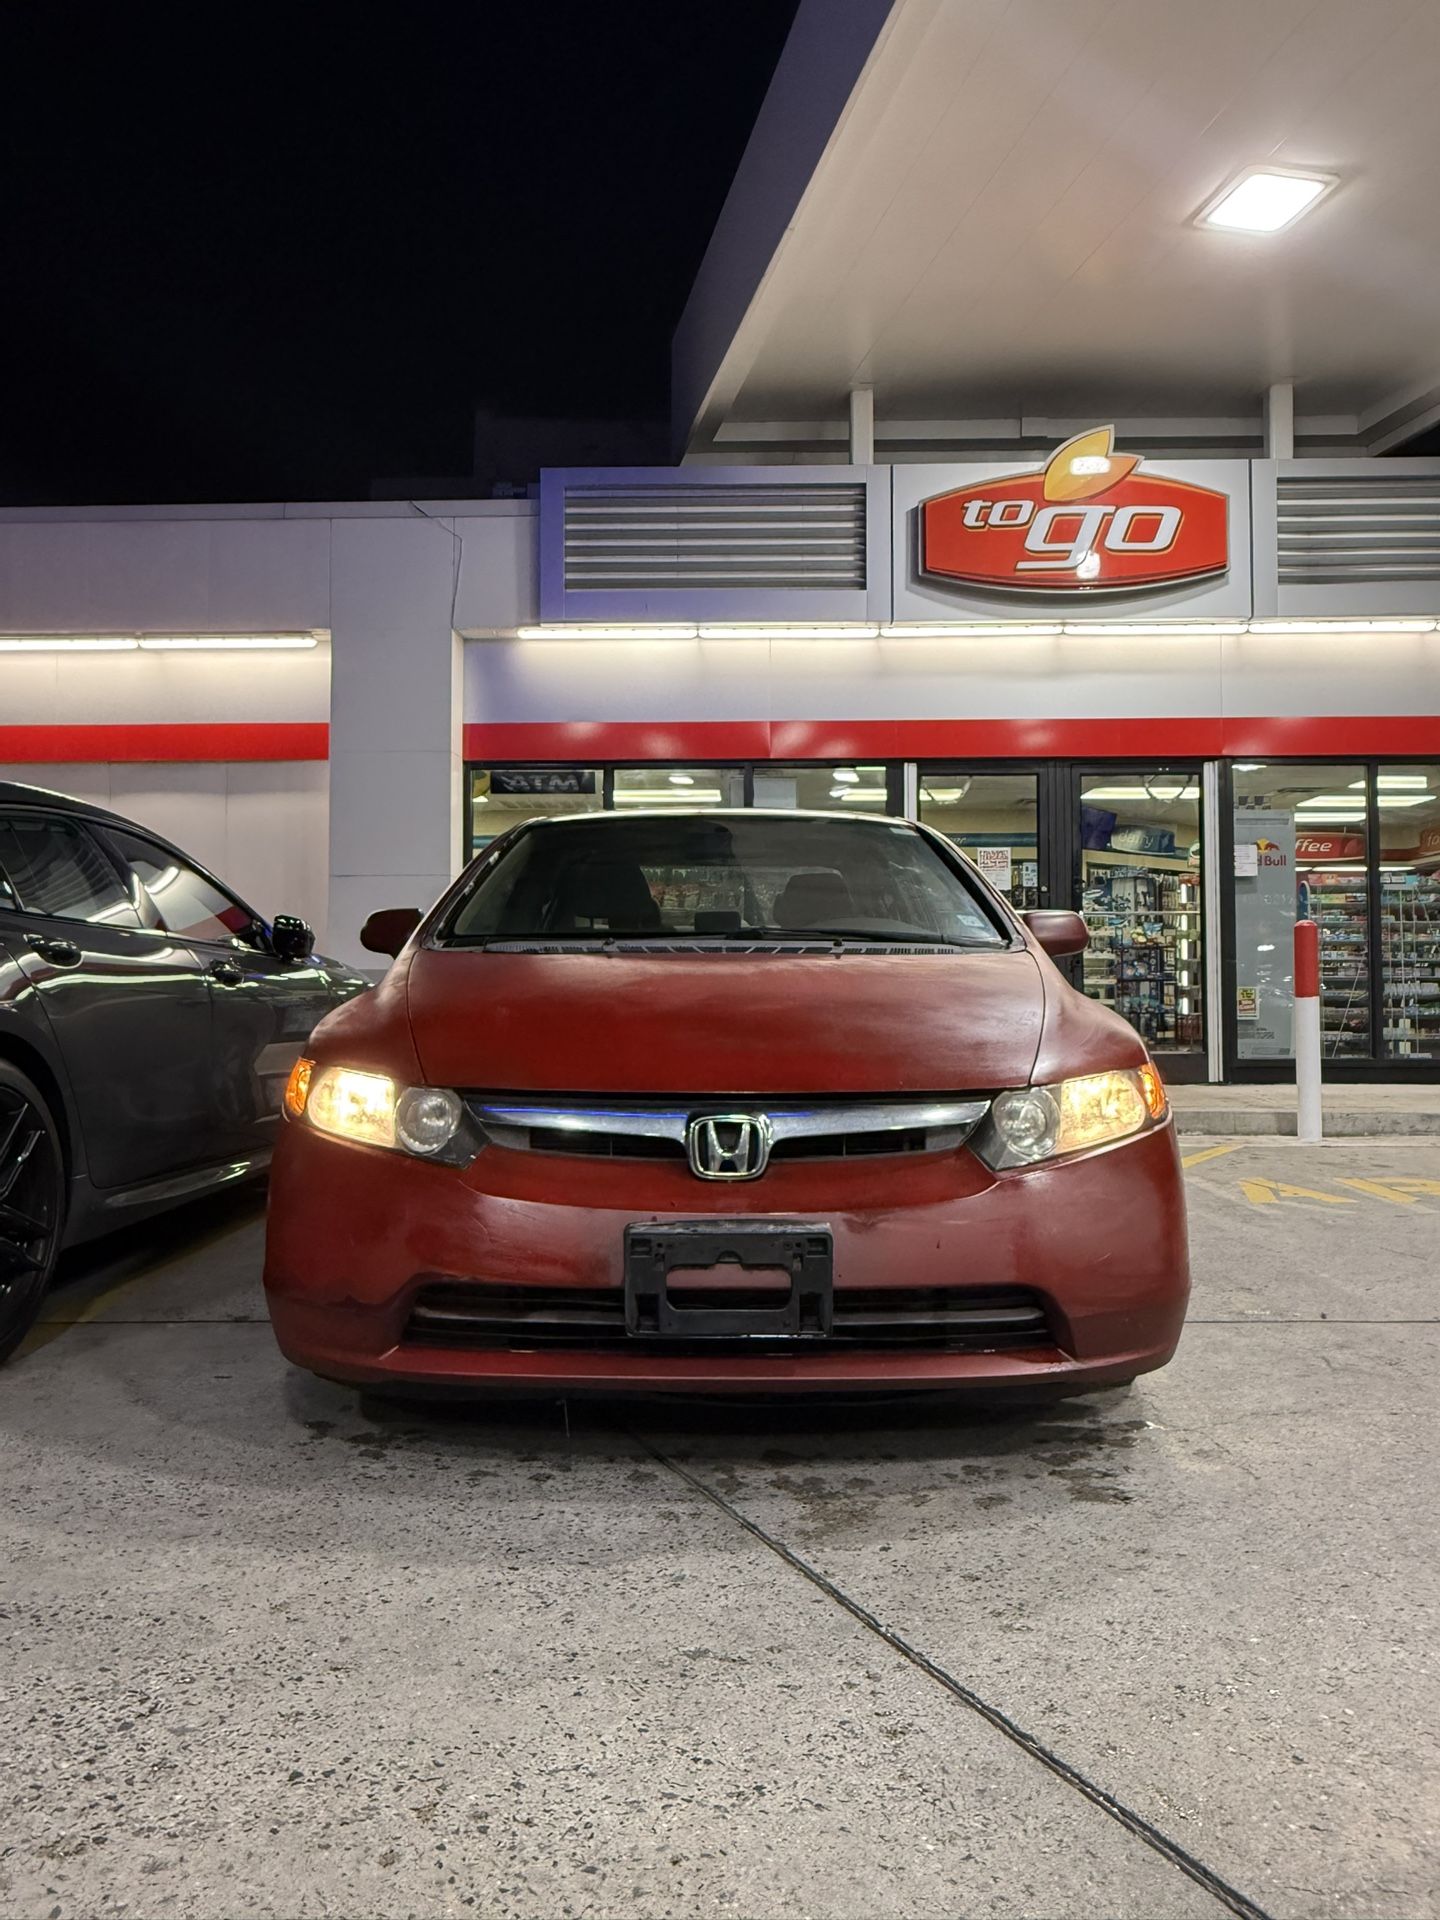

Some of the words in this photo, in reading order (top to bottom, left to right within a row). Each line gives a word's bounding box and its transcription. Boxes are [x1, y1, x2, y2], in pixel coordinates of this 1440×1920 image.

[963, 500, 1034, 528] to
[1015, 505, 1183, 572] go
[508, 775, 580, 791] ATM
[1295, 838, 1333, 852] ffee
[1264, 855, 1286, 866] Bull
